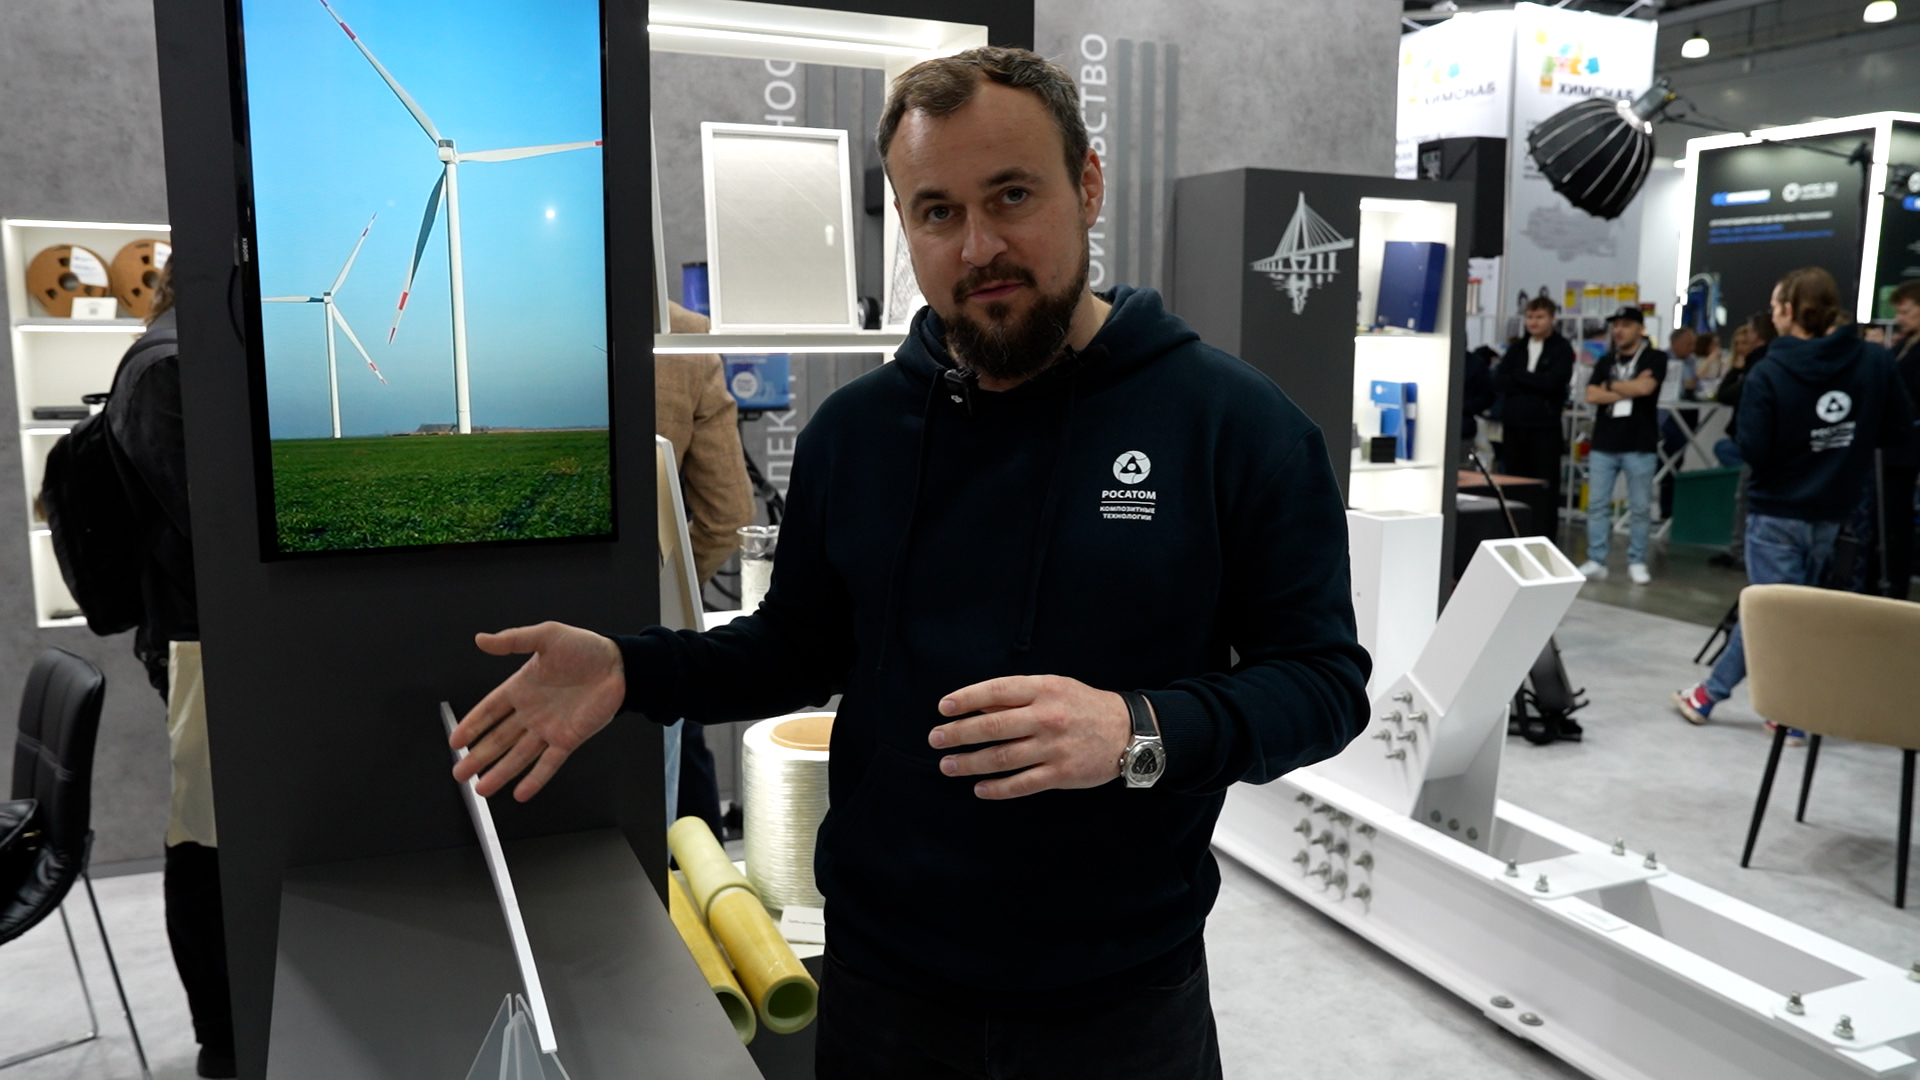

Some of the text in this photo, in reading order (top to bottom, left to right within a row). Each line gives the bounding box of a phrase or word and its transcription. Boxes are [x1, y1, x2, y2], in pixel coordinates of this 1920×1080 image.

[1101, 490, 1156, 500] РОСАТОМ
[1099, 506, 1155, 514] КОМПОЗИТНЫЕ
[1102, 513, 1152, 521] ТЕХНОЛОГИИ
